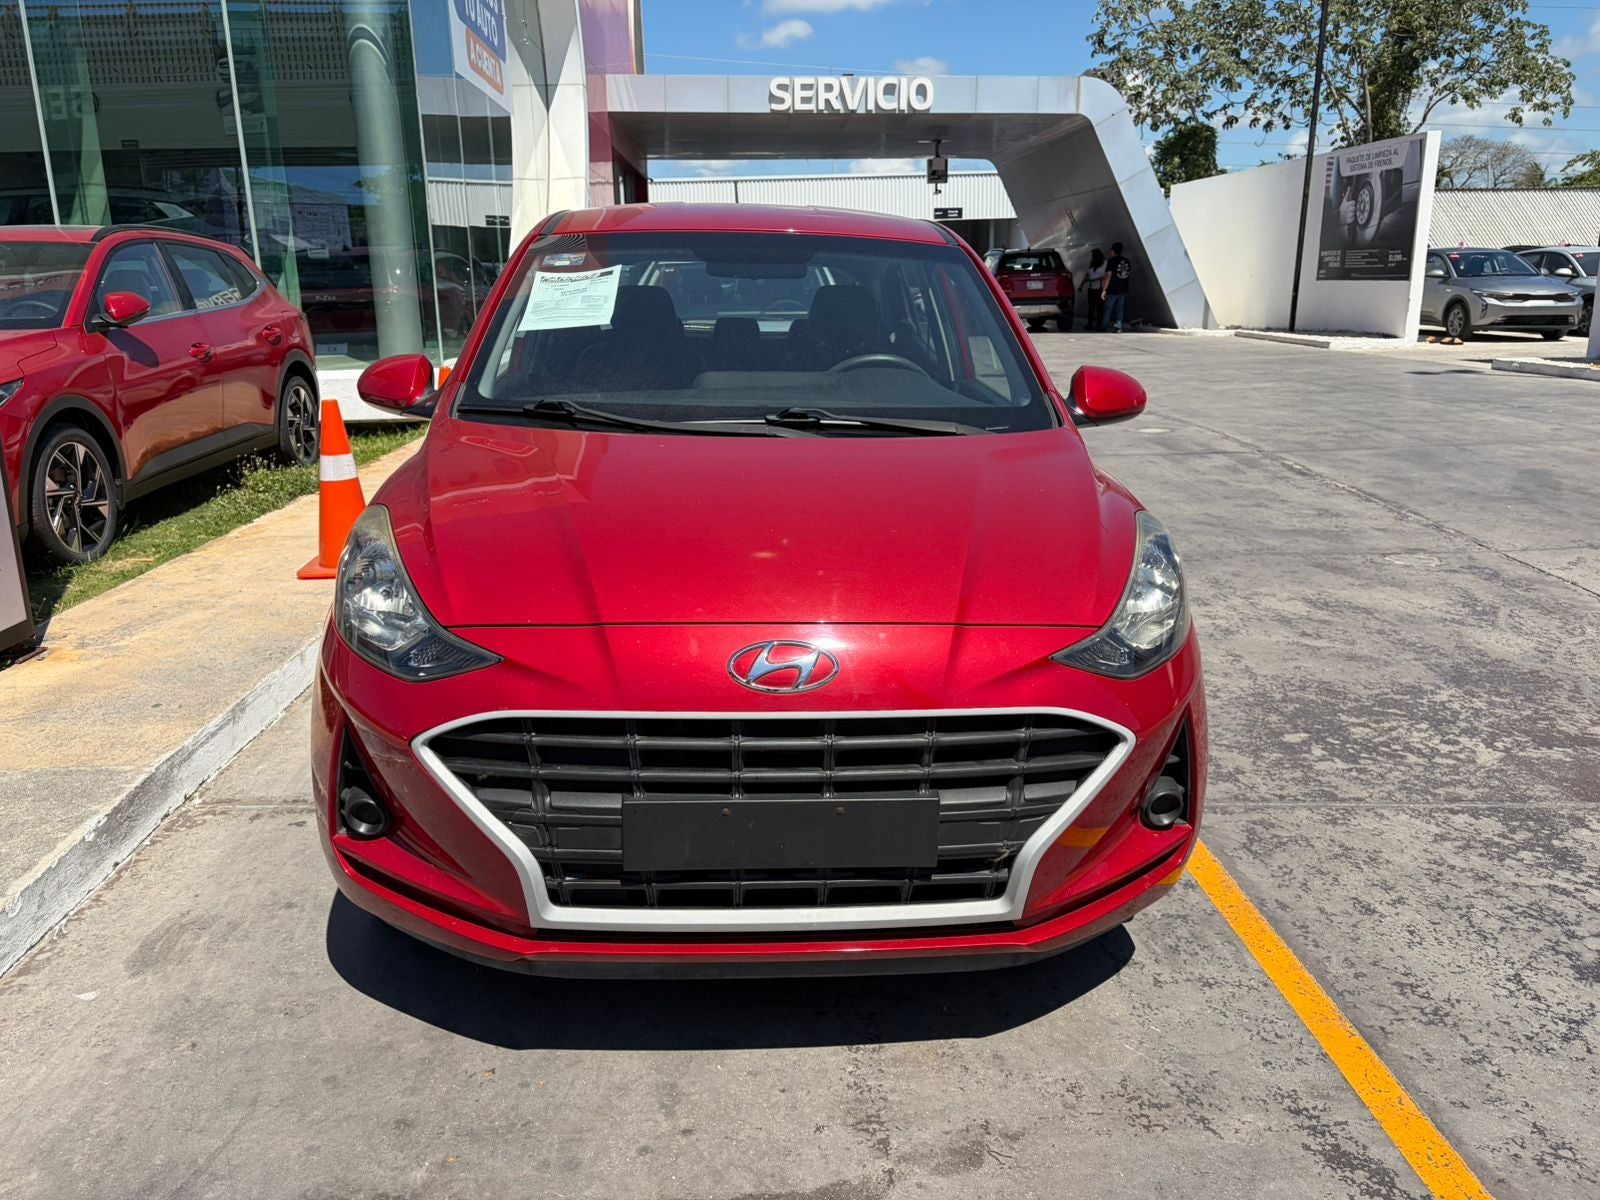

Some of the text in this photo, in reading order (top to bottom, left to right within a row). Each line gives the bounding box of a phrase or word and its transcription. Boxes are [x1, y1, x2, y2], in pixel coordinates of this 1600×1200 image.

[476, 0, 498, 47] AUTO
[475, 43, 502, 86] CUENTA
[769, 76, 934, 112] SERVICIO
